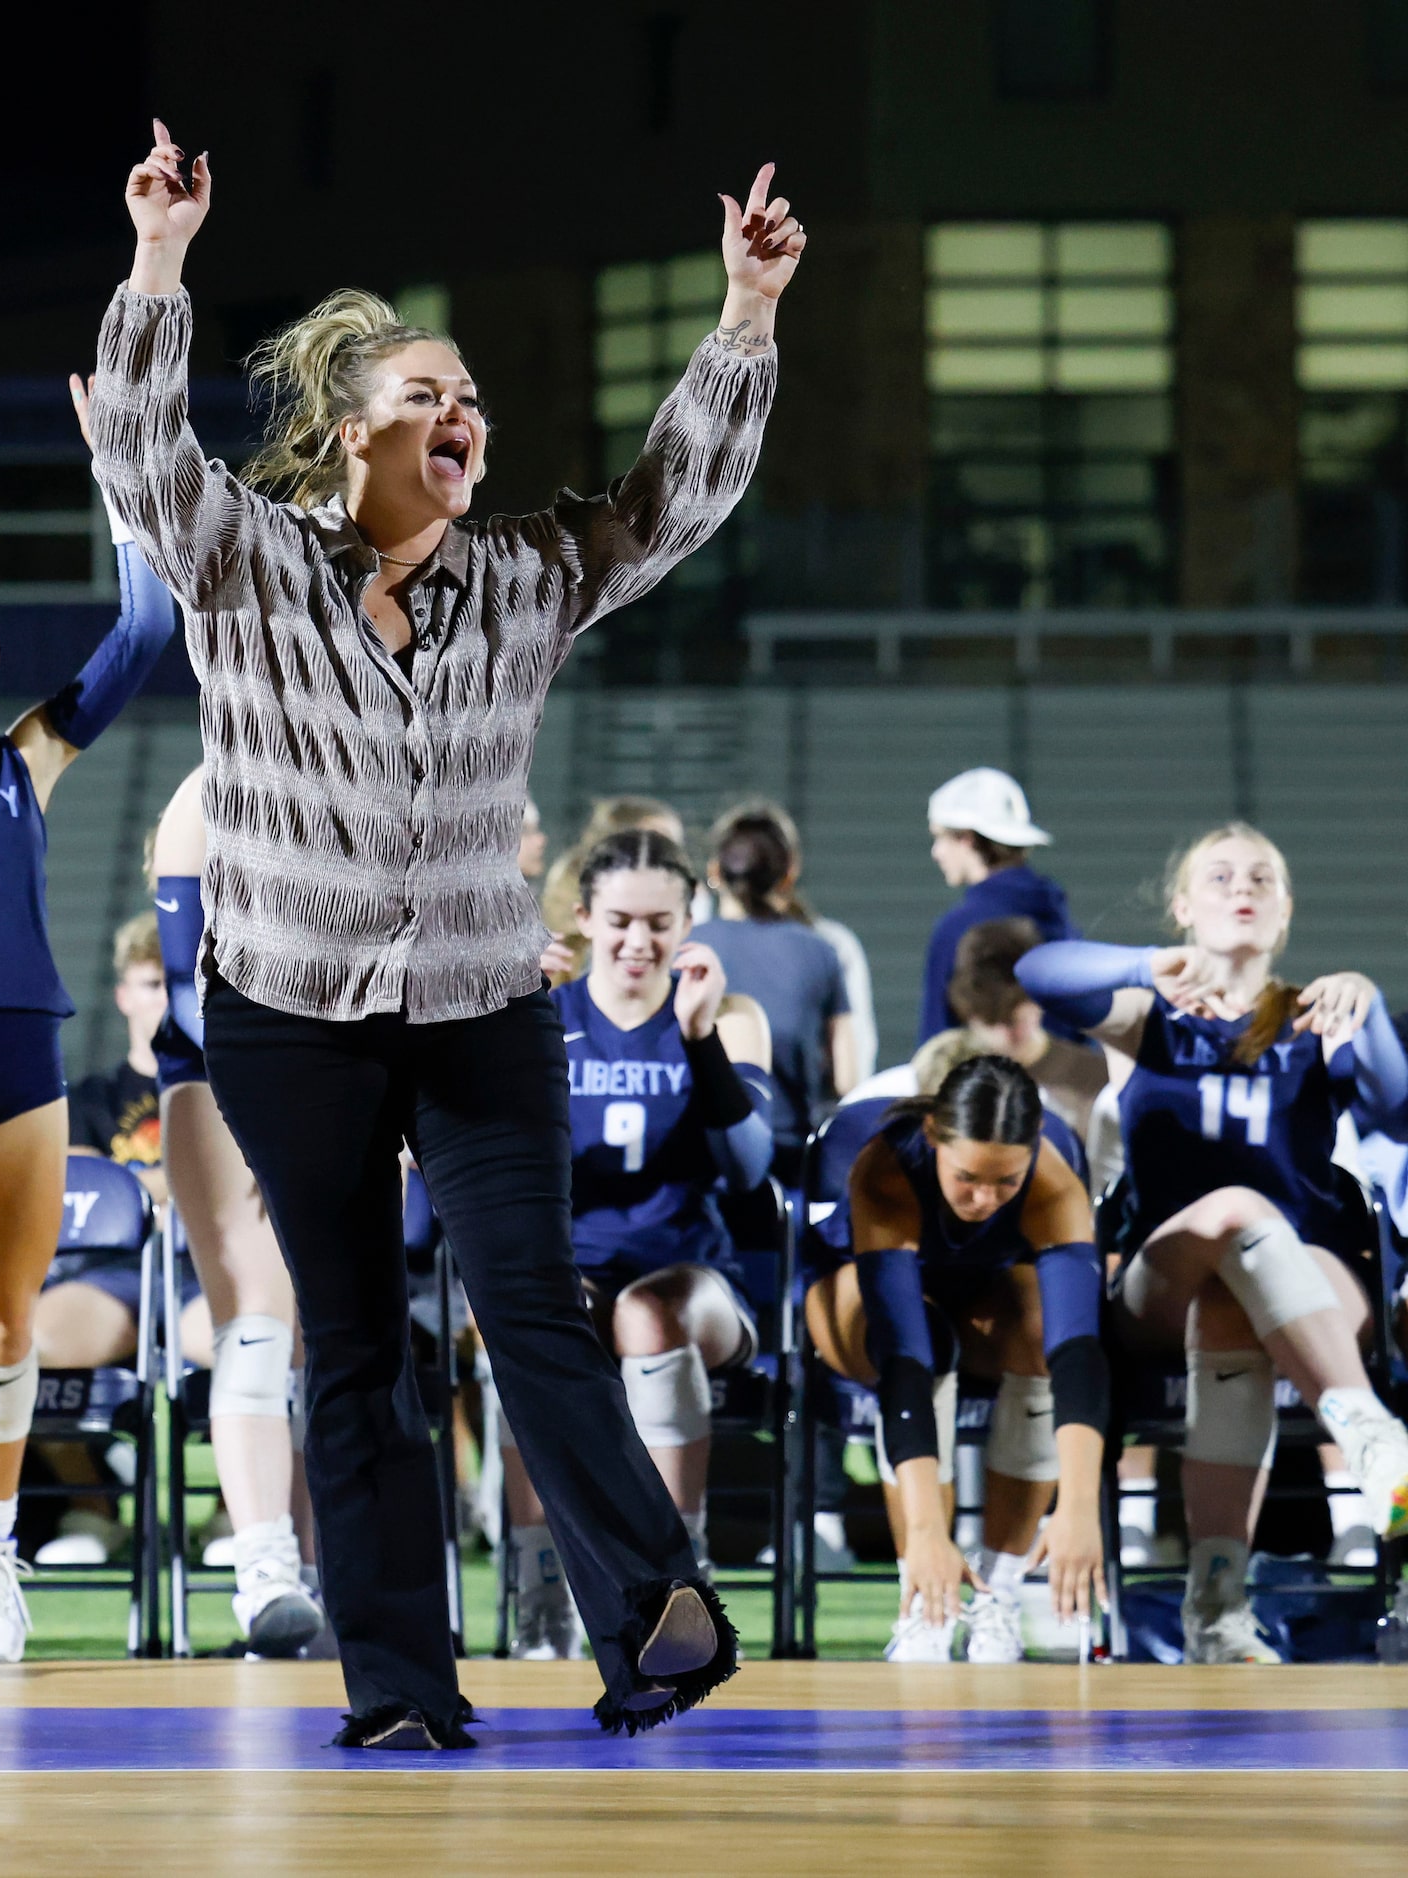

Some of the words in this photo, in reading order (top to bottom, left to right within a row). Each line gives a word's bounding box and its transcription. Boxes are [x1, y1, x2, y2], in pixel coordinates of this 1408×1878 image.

[567, 1059, 687, 1096] LIBERTY
[1197, 1073, 1272, 1147] 14
[603, 1100, 646, 1173] 9
